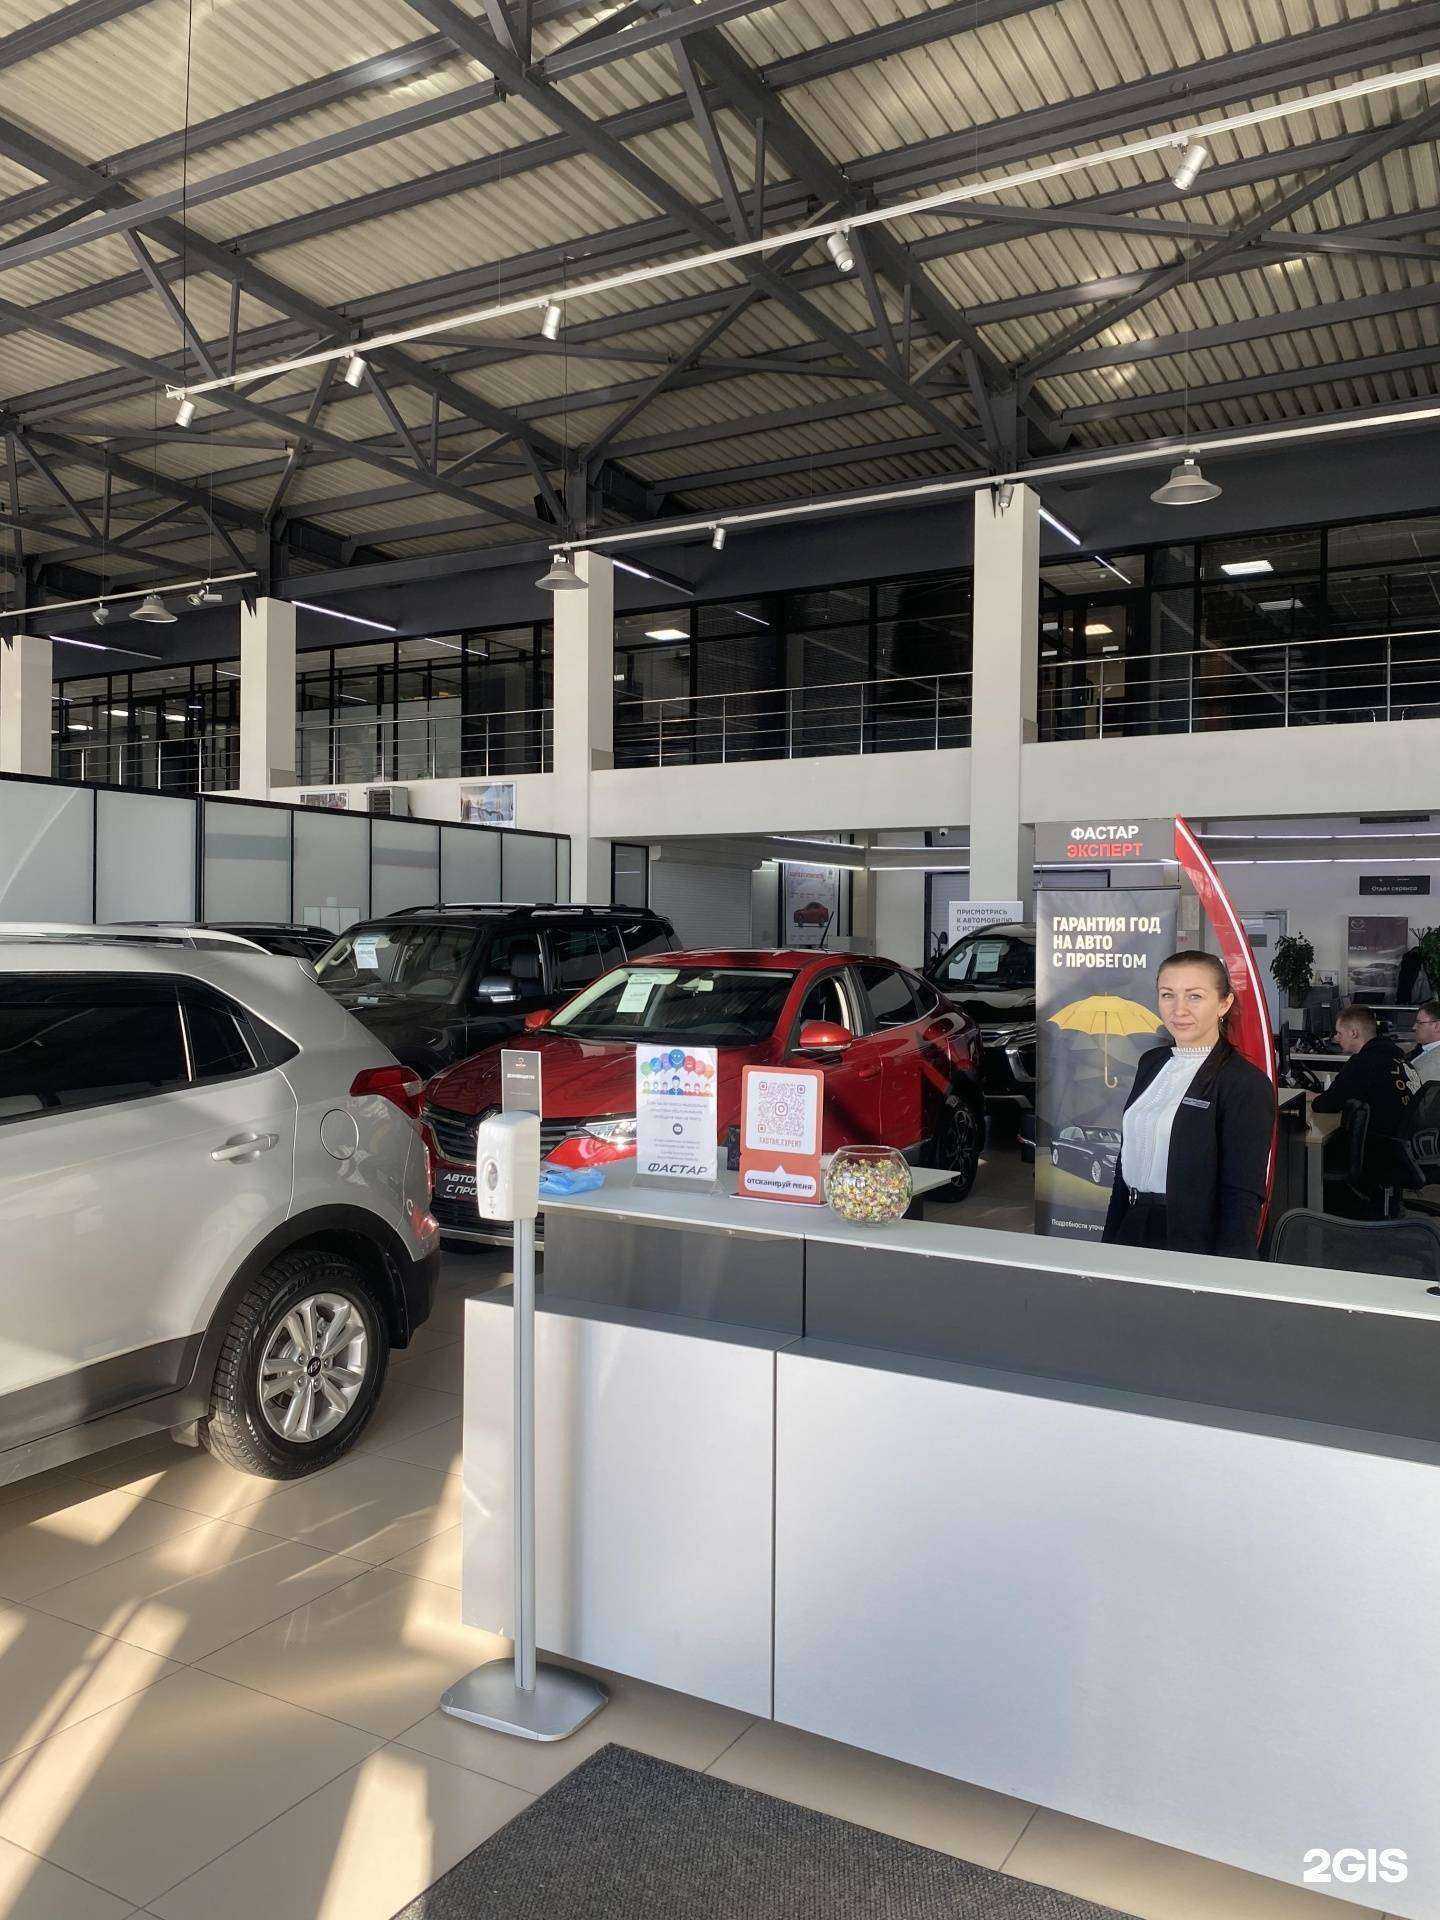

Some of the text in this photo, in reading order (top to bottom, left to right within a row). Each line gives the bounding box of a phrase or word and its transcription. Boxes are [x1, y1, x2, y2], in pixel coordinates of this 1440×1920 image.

[1071, 825, 1139, 840] ФАСТАР
[1067, 842, 1143, 858] ЭКСПЕРТ
[1053, 916, 1162, 934] ГАРАНТИЯ ГОД
[1053, 935, 1113, 950] НА АВТО
[1053, 953, 1147, 968] С ПРОБЕГОМ
[647, 1163, 708, 1176] ФАСТАР
[746, 1179, 813, 1190] отсканируй меня
[1051, 1218, 1088, 1229] Подробности
